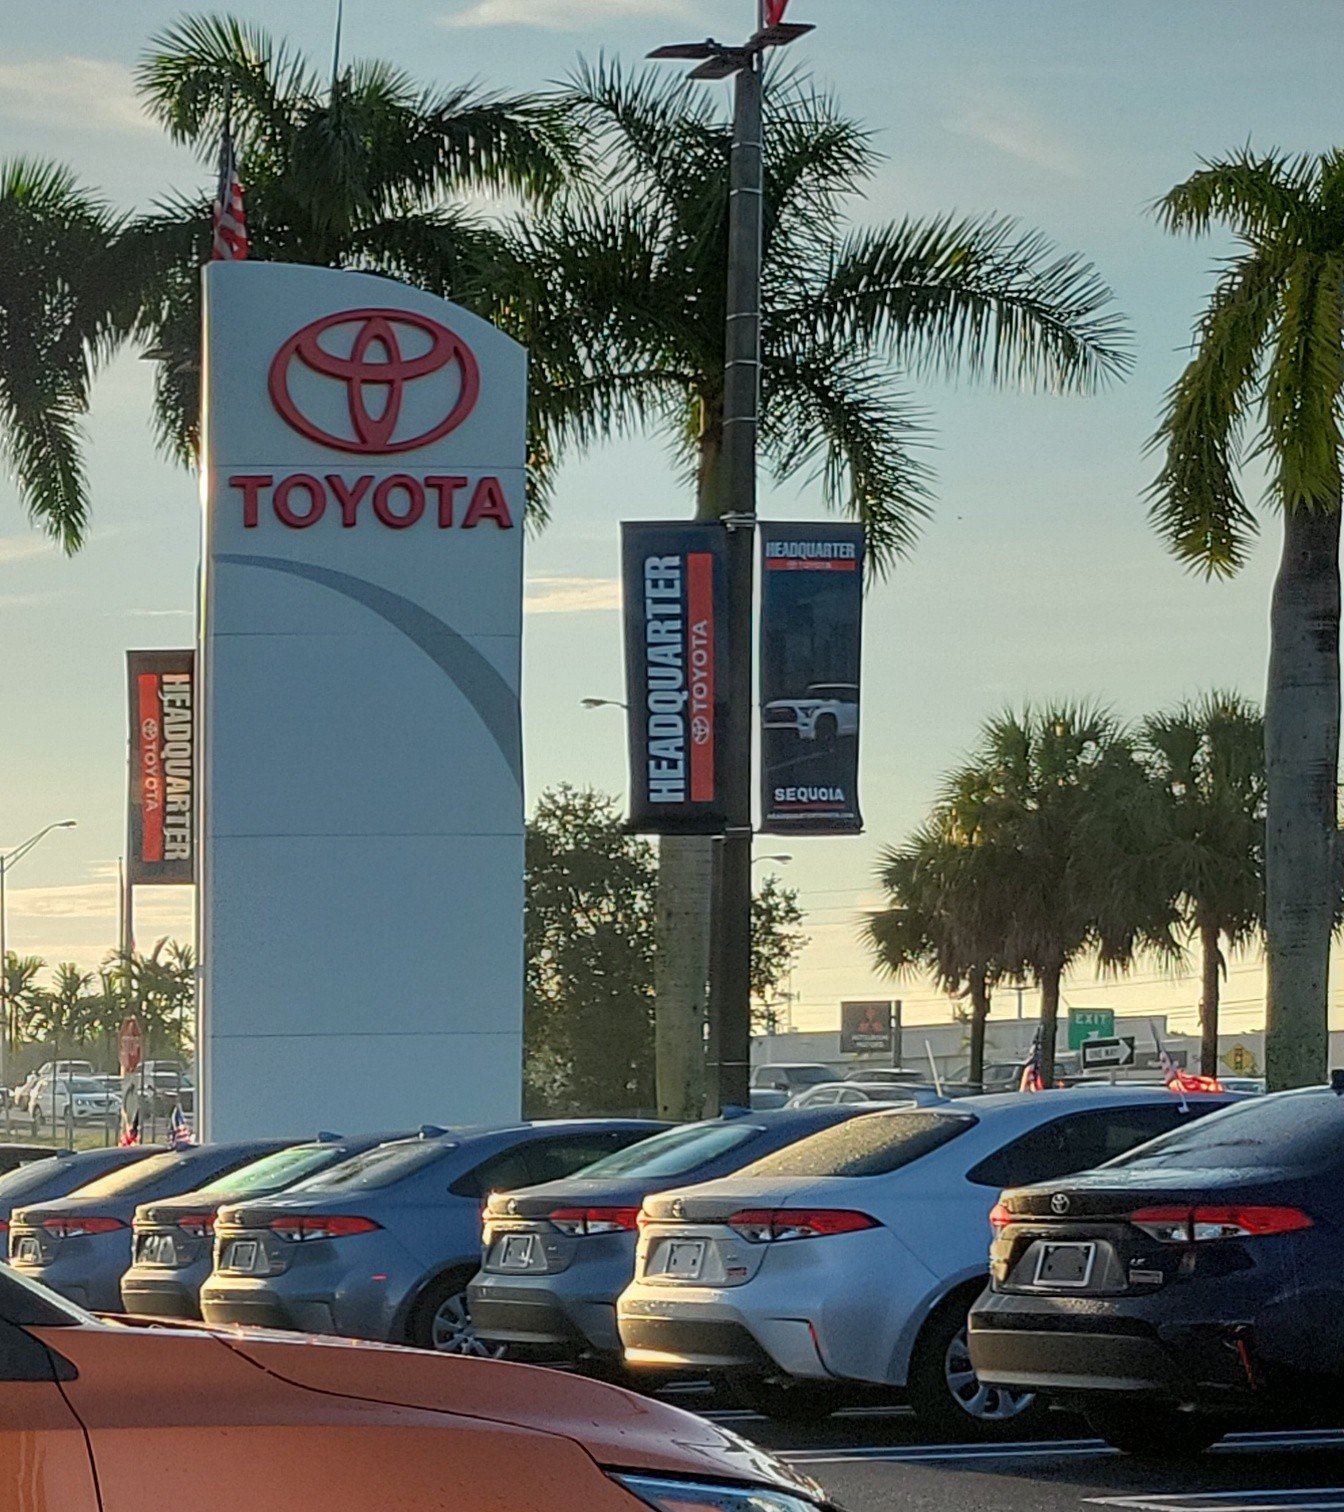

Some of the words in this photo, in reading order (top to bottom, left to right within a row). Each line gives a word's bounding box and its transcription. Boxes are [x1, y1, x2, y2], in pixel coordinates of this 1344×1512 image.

[229, 473, 514, 530] TOYOTA
[765, 541, 856, 559] HEADQUARTER
[645, 554, 689, 804] HEADQUARTER
[692, 619, 709, 714] TOYOTA
[145, 739, 160, 812] TOYOTA
[160, 673, 194, 862] HEADQUARTER
[774, 787, 845, 803] SEQUOIA
[1075, 1013, 1109, 1025] EXIT
